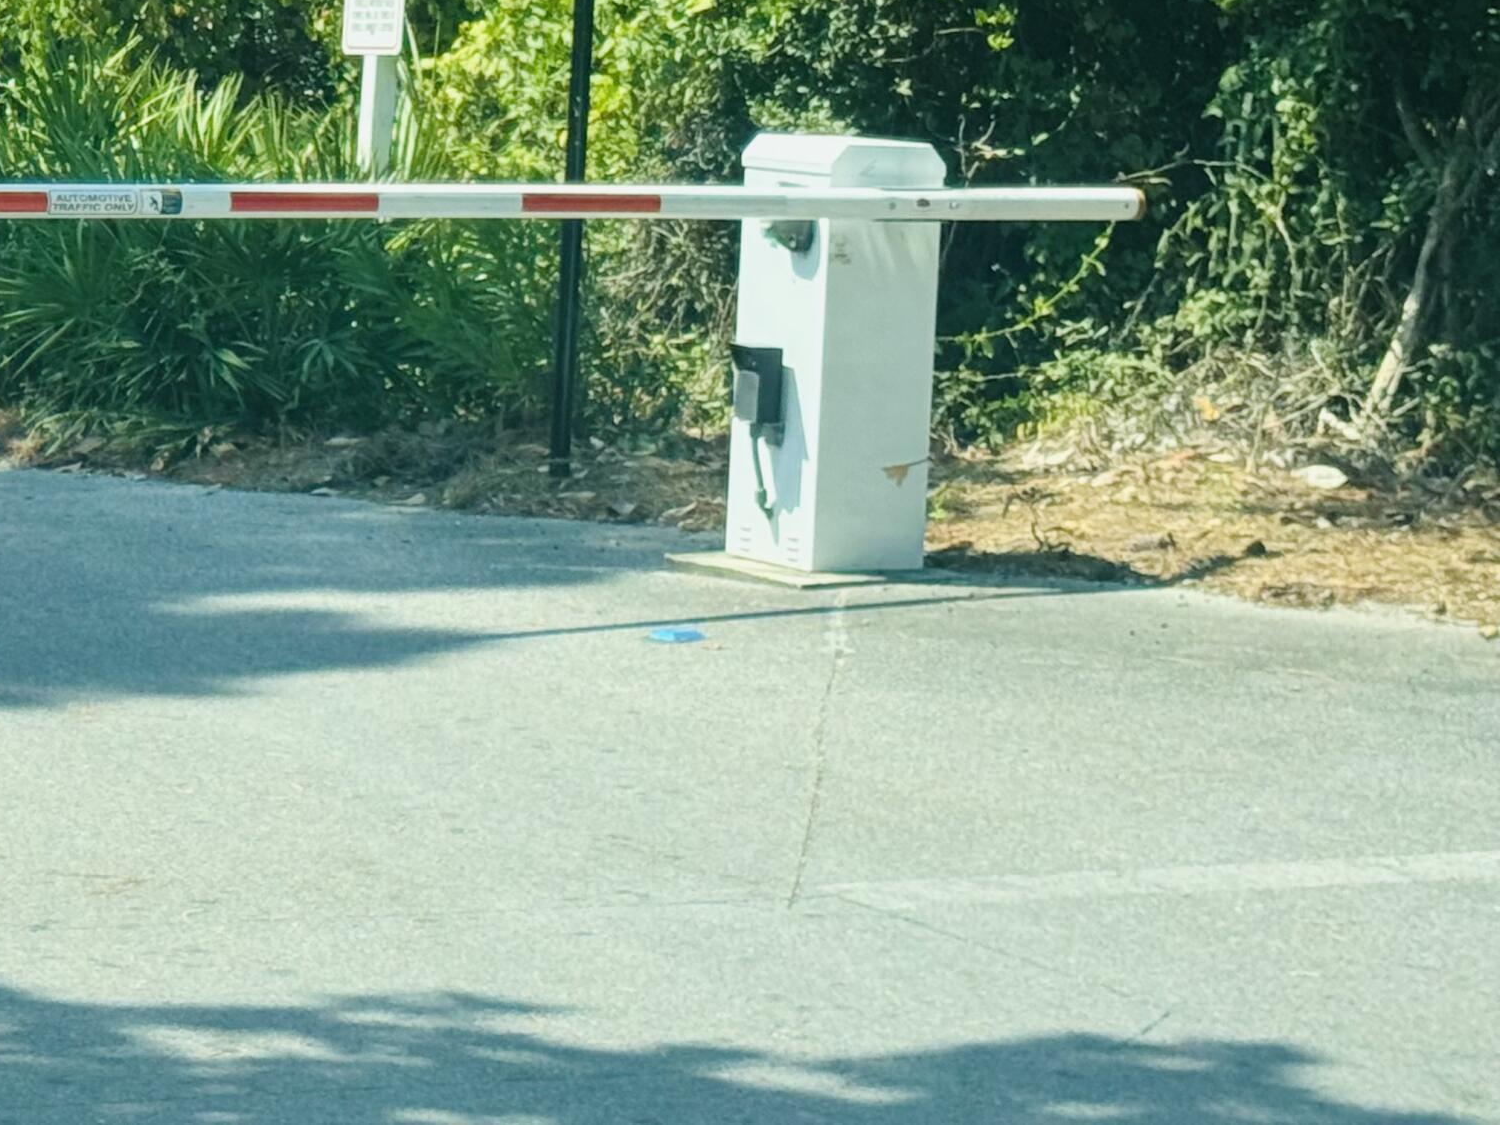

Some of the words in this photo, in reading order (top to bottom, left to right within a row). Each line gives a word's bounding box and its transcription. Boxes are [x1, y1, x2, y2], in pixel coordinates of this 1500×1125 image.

[56, 194, 133, 203] AUTOMOTIVE
[53, 203, 102, 212] TRAFFIC
[104, 203, 135, 212] ONLY
